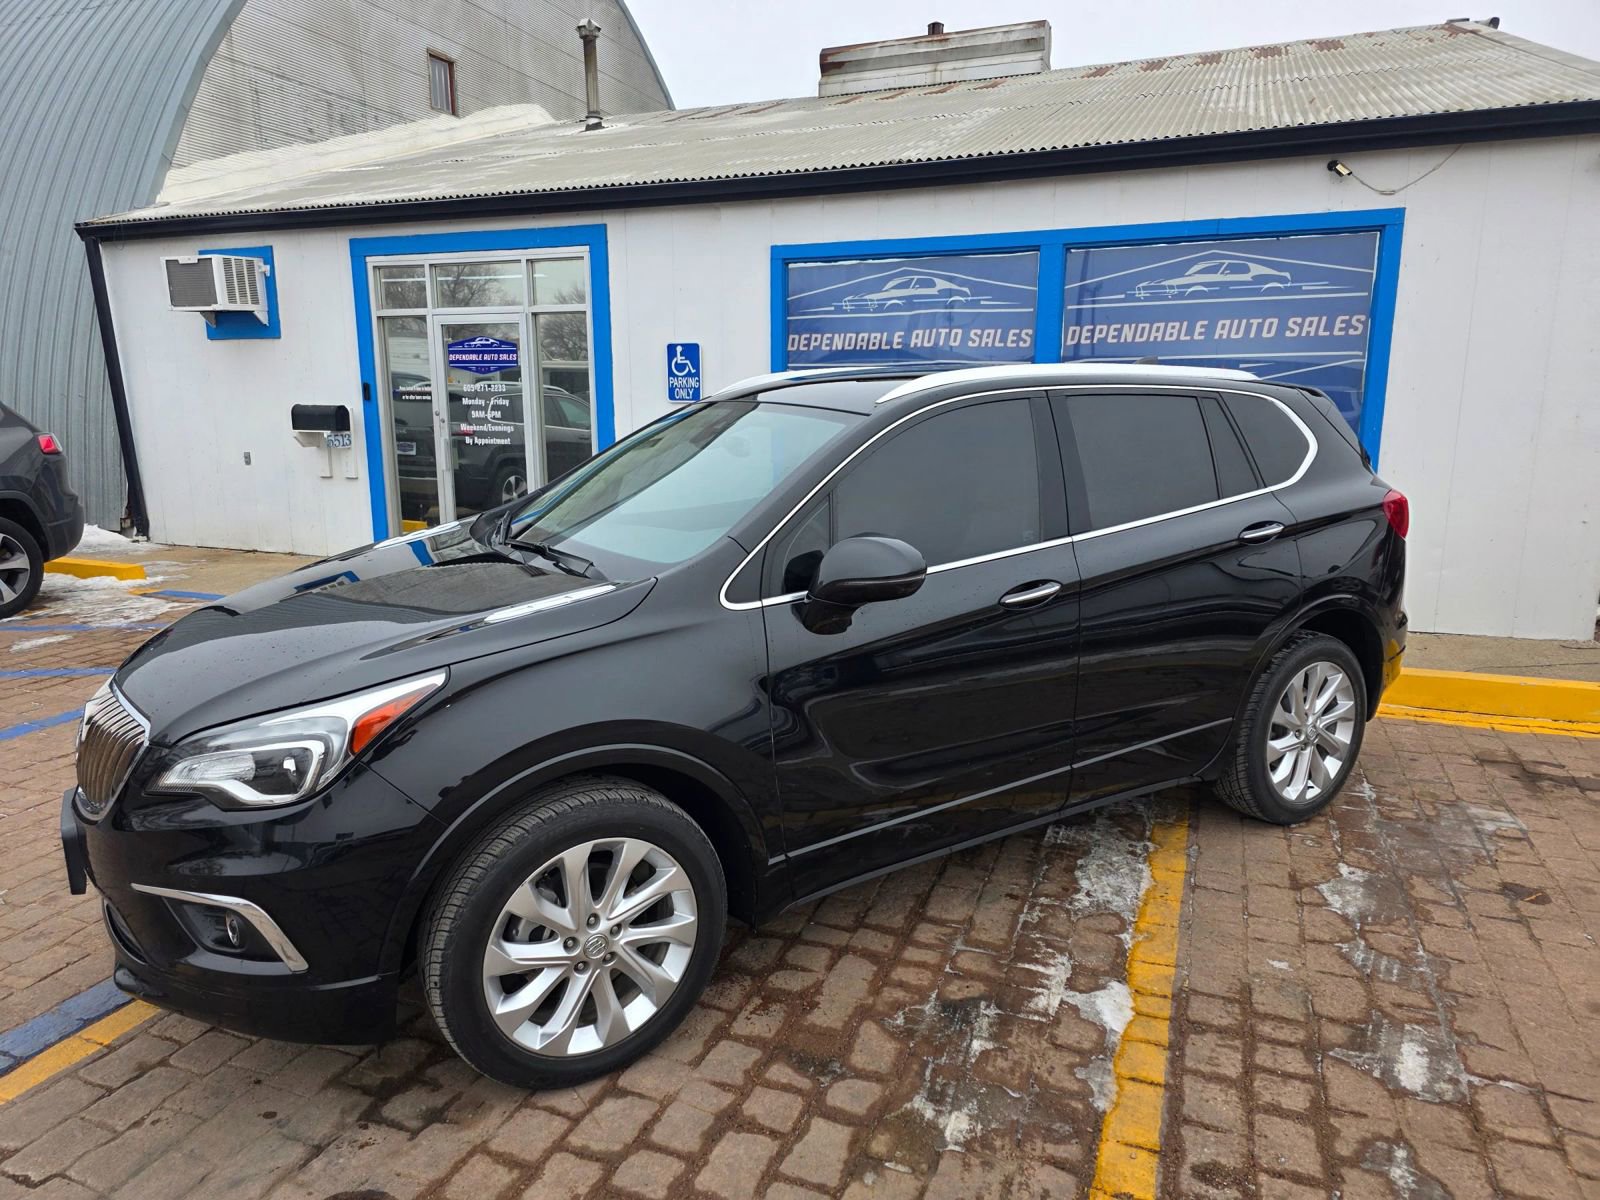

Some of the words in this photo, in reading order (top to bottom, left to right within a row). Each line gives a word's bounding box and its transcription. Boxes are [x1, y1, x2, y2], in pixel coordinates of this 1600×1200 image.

[1066, 320, 1209, 346] DEPENDABLE
[1214, 318, 1279, 340] AUTO
[1285, 314, 1367, 338] SALES
[787, 331, 905, 352] DEPENDABLE
[910, 328, 961, 348] AUTO
[967, 328, 1034, 348] SALES
[448, 353, 482, 361] DEPENDABLE
[483, 353, 499, 361] AUTO
[499, 353, 517, 361] SALES
[669, 376, 700, 389] PARKING
[674, 388, 694, 400] ONLY
[462, 397, 485, 407] Monday
[326, 433, 352, 449] 5513
[474, 436, 511, 446] Appointment
